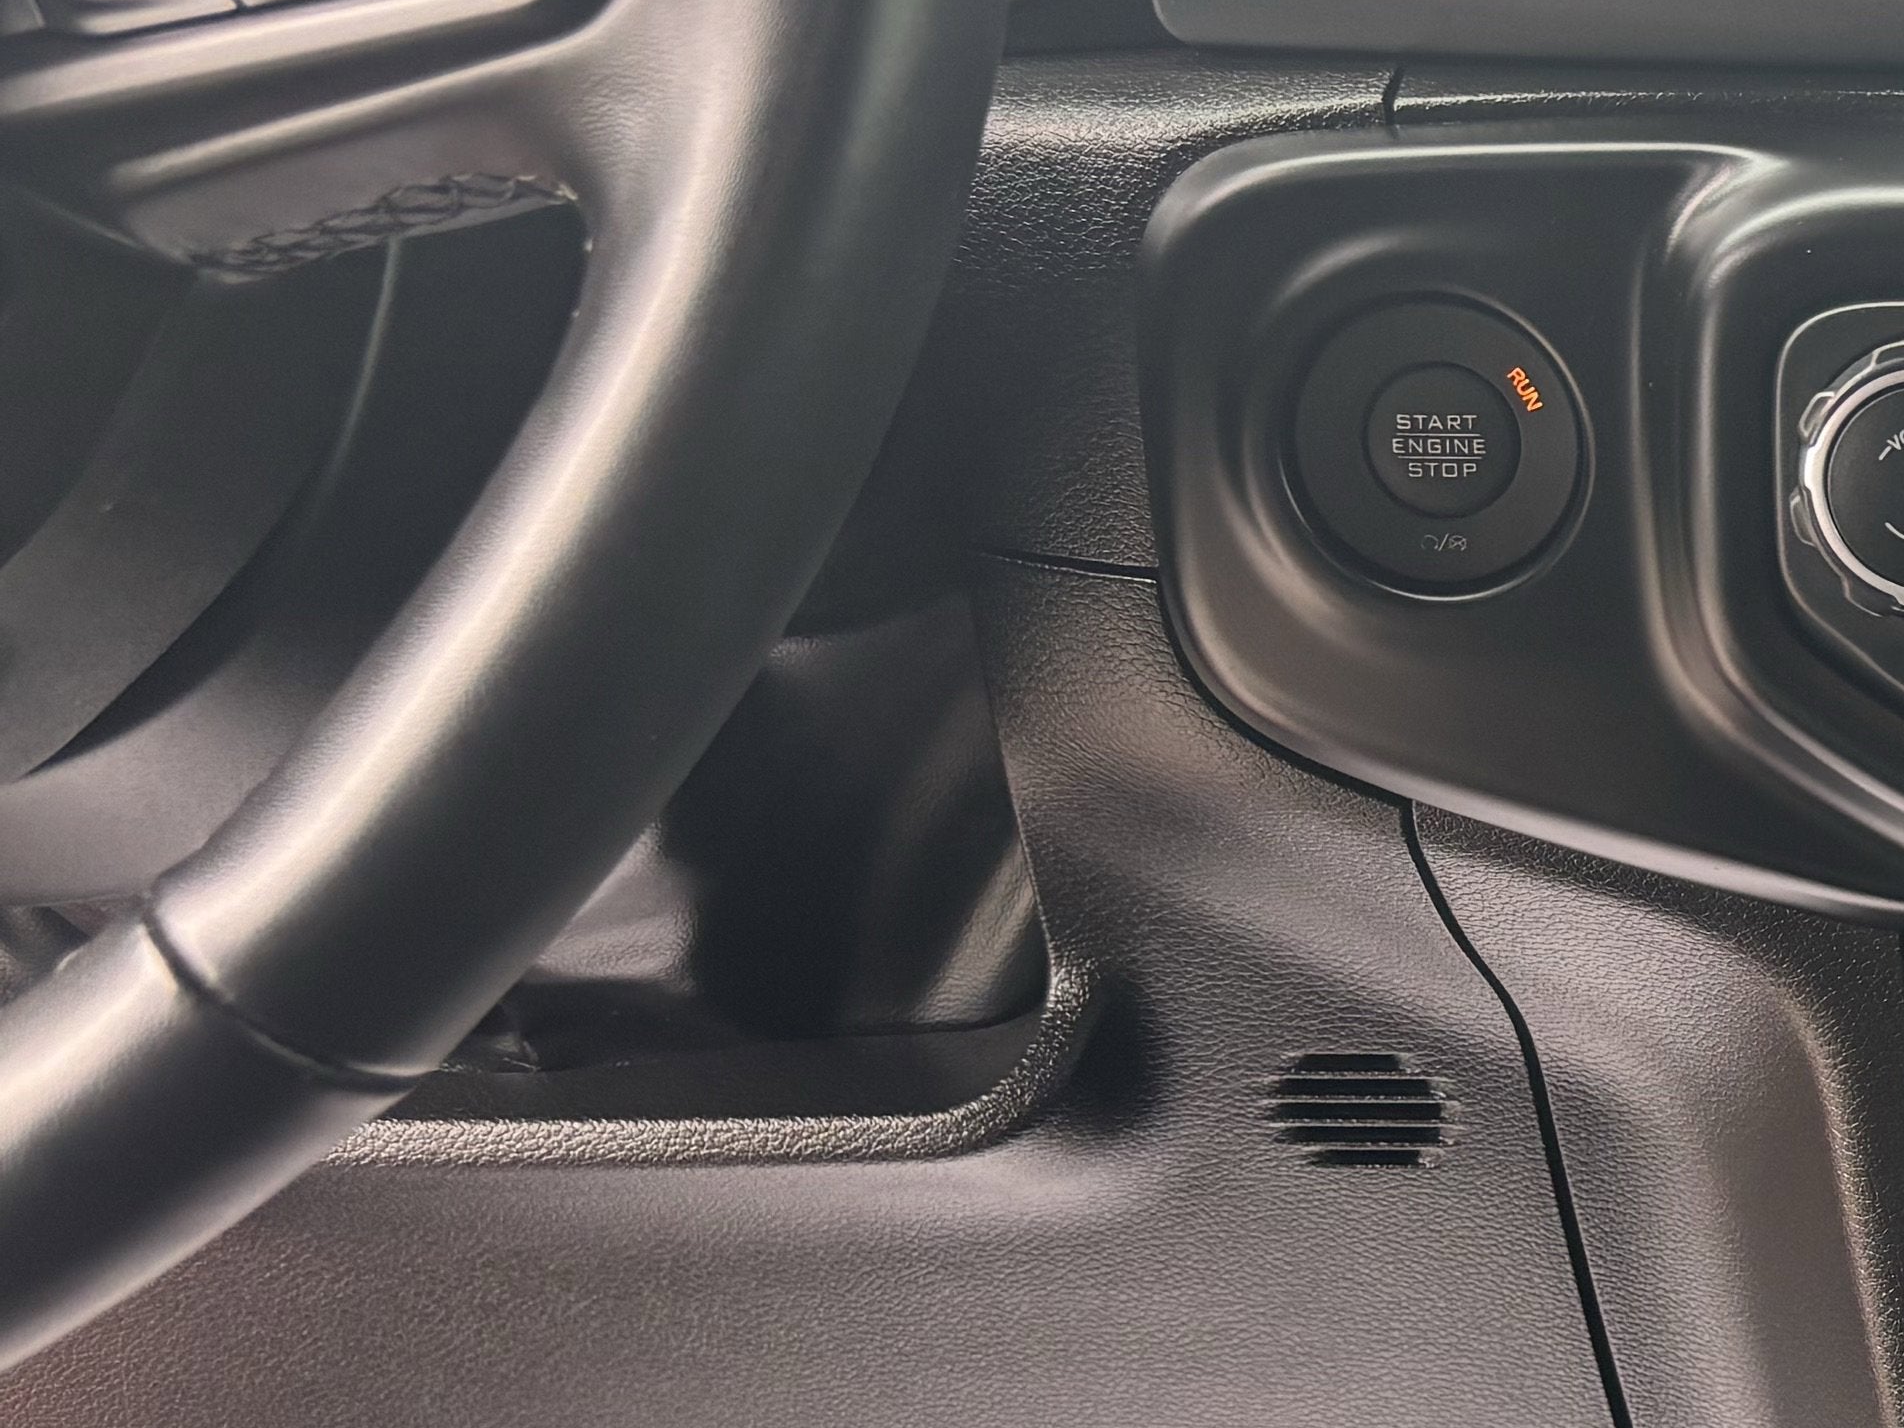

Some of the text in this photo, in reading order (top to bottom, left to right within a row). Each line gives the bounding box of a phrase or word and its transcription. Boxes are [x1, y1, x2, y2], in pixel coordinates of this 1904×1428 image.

[1506, 366, 1545, 414] RUN
[1396, 414, 1477, 431] START
[1392, 438, 1487, 455] ENGINE
[1408, 462, 1477, 479] STOP
